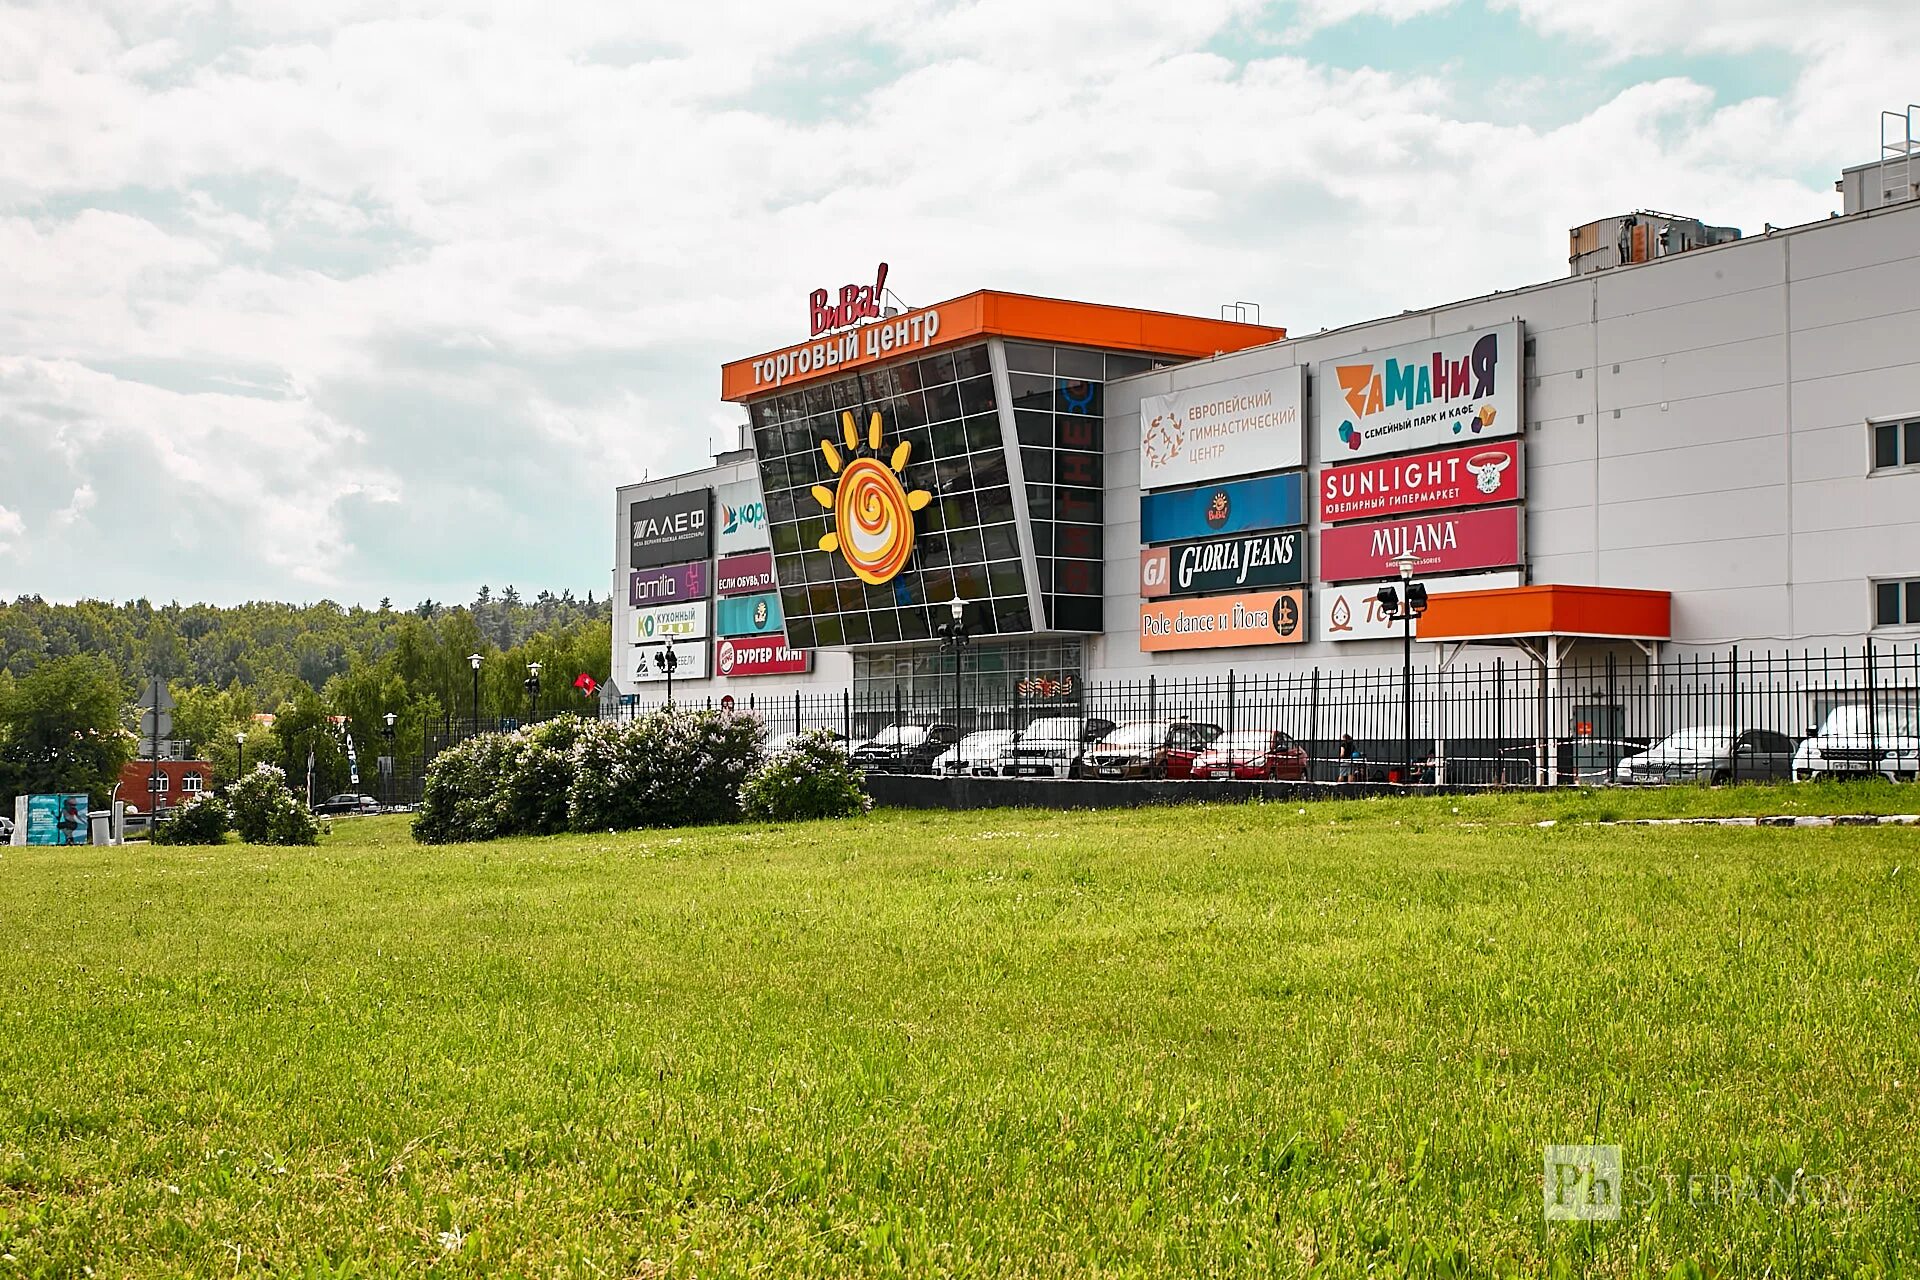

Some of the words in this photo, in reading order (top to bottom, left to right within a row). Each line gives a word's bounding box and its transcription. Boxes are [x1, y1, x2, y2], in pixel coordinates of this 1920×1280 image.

[752, 330, 859, 386] торговый
[866, 310, 940, 357] центр
[1189, 388, 1272, 420] ЕВРОПЕЙСКИЙ
[1189, 406, 1296, 441] ГИМНАСТИЧЕСКИЙ
[1364, 418, 1412, 439] СЕМЕЙНЫЙ
[1413, 413, 1437, 427] ПАРК
[1439, 411, 1446, 421] И
[1449, 404, 1474, 418] КАФЕ
[1189, 444, 1225, 464] ЦЕНТР
[1326, 457, 1460, 500] SUNLIGHT
[1325, 497, 1385, 514] ЮВЕЛИРНЫЙ
[1389, 488, 1460, 506] ГИПЕРМАРКЕТ
[1370, 521, 1457, 557] MILANA
[1178, 542, 1239, 588] GLORIA
[1236, 534, 1295, 584] JEANS
[635, 573, 675, 599] familia
[718, 577, 736, 590] ЕСЛИ
[736, 575, 759, 588] ОБУВЬ,
[760, 573, 770, 585] ТО
[656, 607, 696, 624] КУХОННЫЙ
[1143, 613, 1171, 636] Pole
[1175, 610, 1214, 633] dance
[1232, 602, 1268, 629] Йога
[677, 655, 696, 666] ЕБЕЛИ
[736, 647, 773, 664] БУРГЕР
